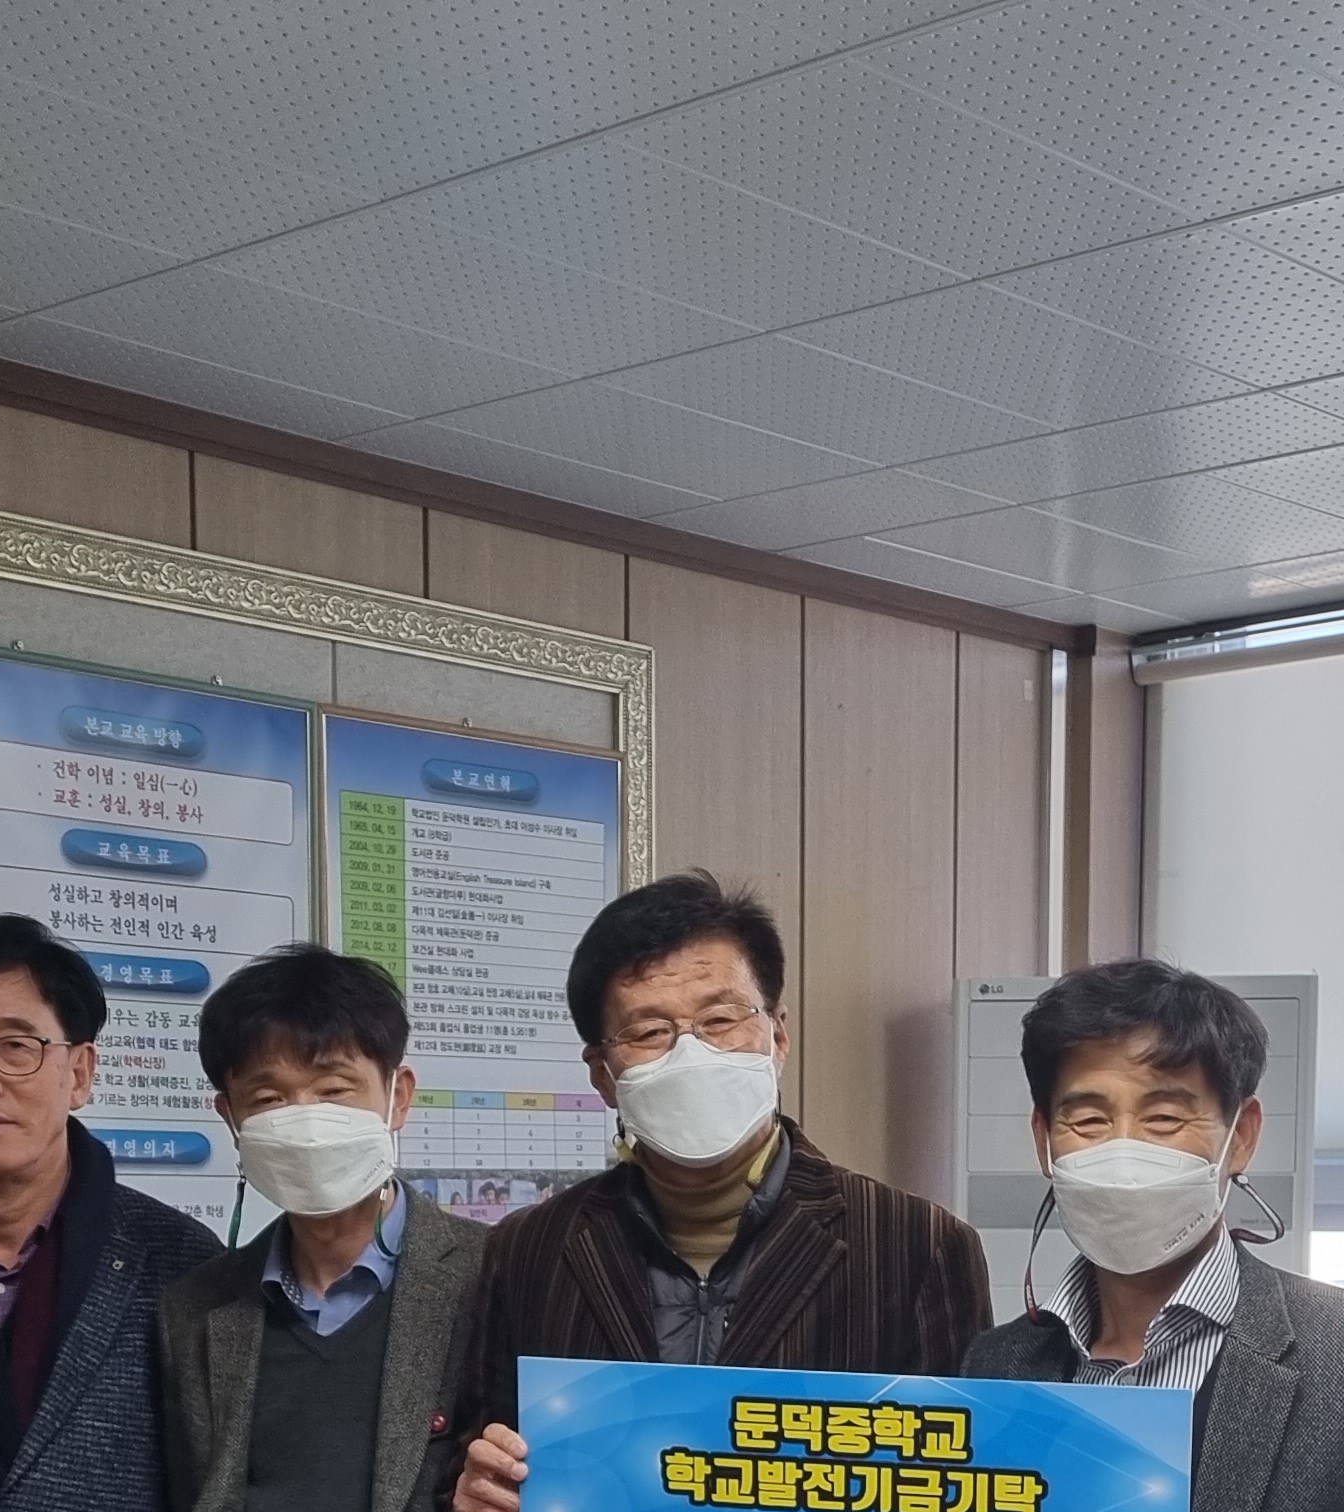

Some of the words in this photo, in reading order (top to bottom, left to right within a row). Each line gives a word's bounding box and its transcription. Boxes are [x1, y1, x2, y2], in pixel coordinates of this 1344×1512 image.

[85, 717, 113, 735] 본교
[120, 723, 148, 745] 교육
[154, 728, 183, 748] 방향
[53, 759, 81, 781] 건학
[87, 764, 114, 785] 이념
[54, 789, 81, 808] 교훈
[176, 804, 204, 824] 봉사
[48, 883, 103, 905] 성실하고
[109, 889, 178, 913] 창의적이며
[49, 910, 104, 933] 봉사하는
[110, 916, 150, 937] 전인적
[158, 921, 184, 940] 인간
[190, 924, 217, 943] 육성
[991, 985, 1004, 993] LG
[145, 1010, 172, 1028] 감동
[160, 1039, 179, 1050] 태도
[97, 1054, 165, 1069] 교실(학력신장)
[105, 1074, 123, 1086] 학교
[99, 1094, 126, 1106] 기르는
[130, 1095, 158, 1107] 창의적
[206, 1206, 224, 1218] 학생
[732, 1400, 970, 1460] 둔덕중학교
